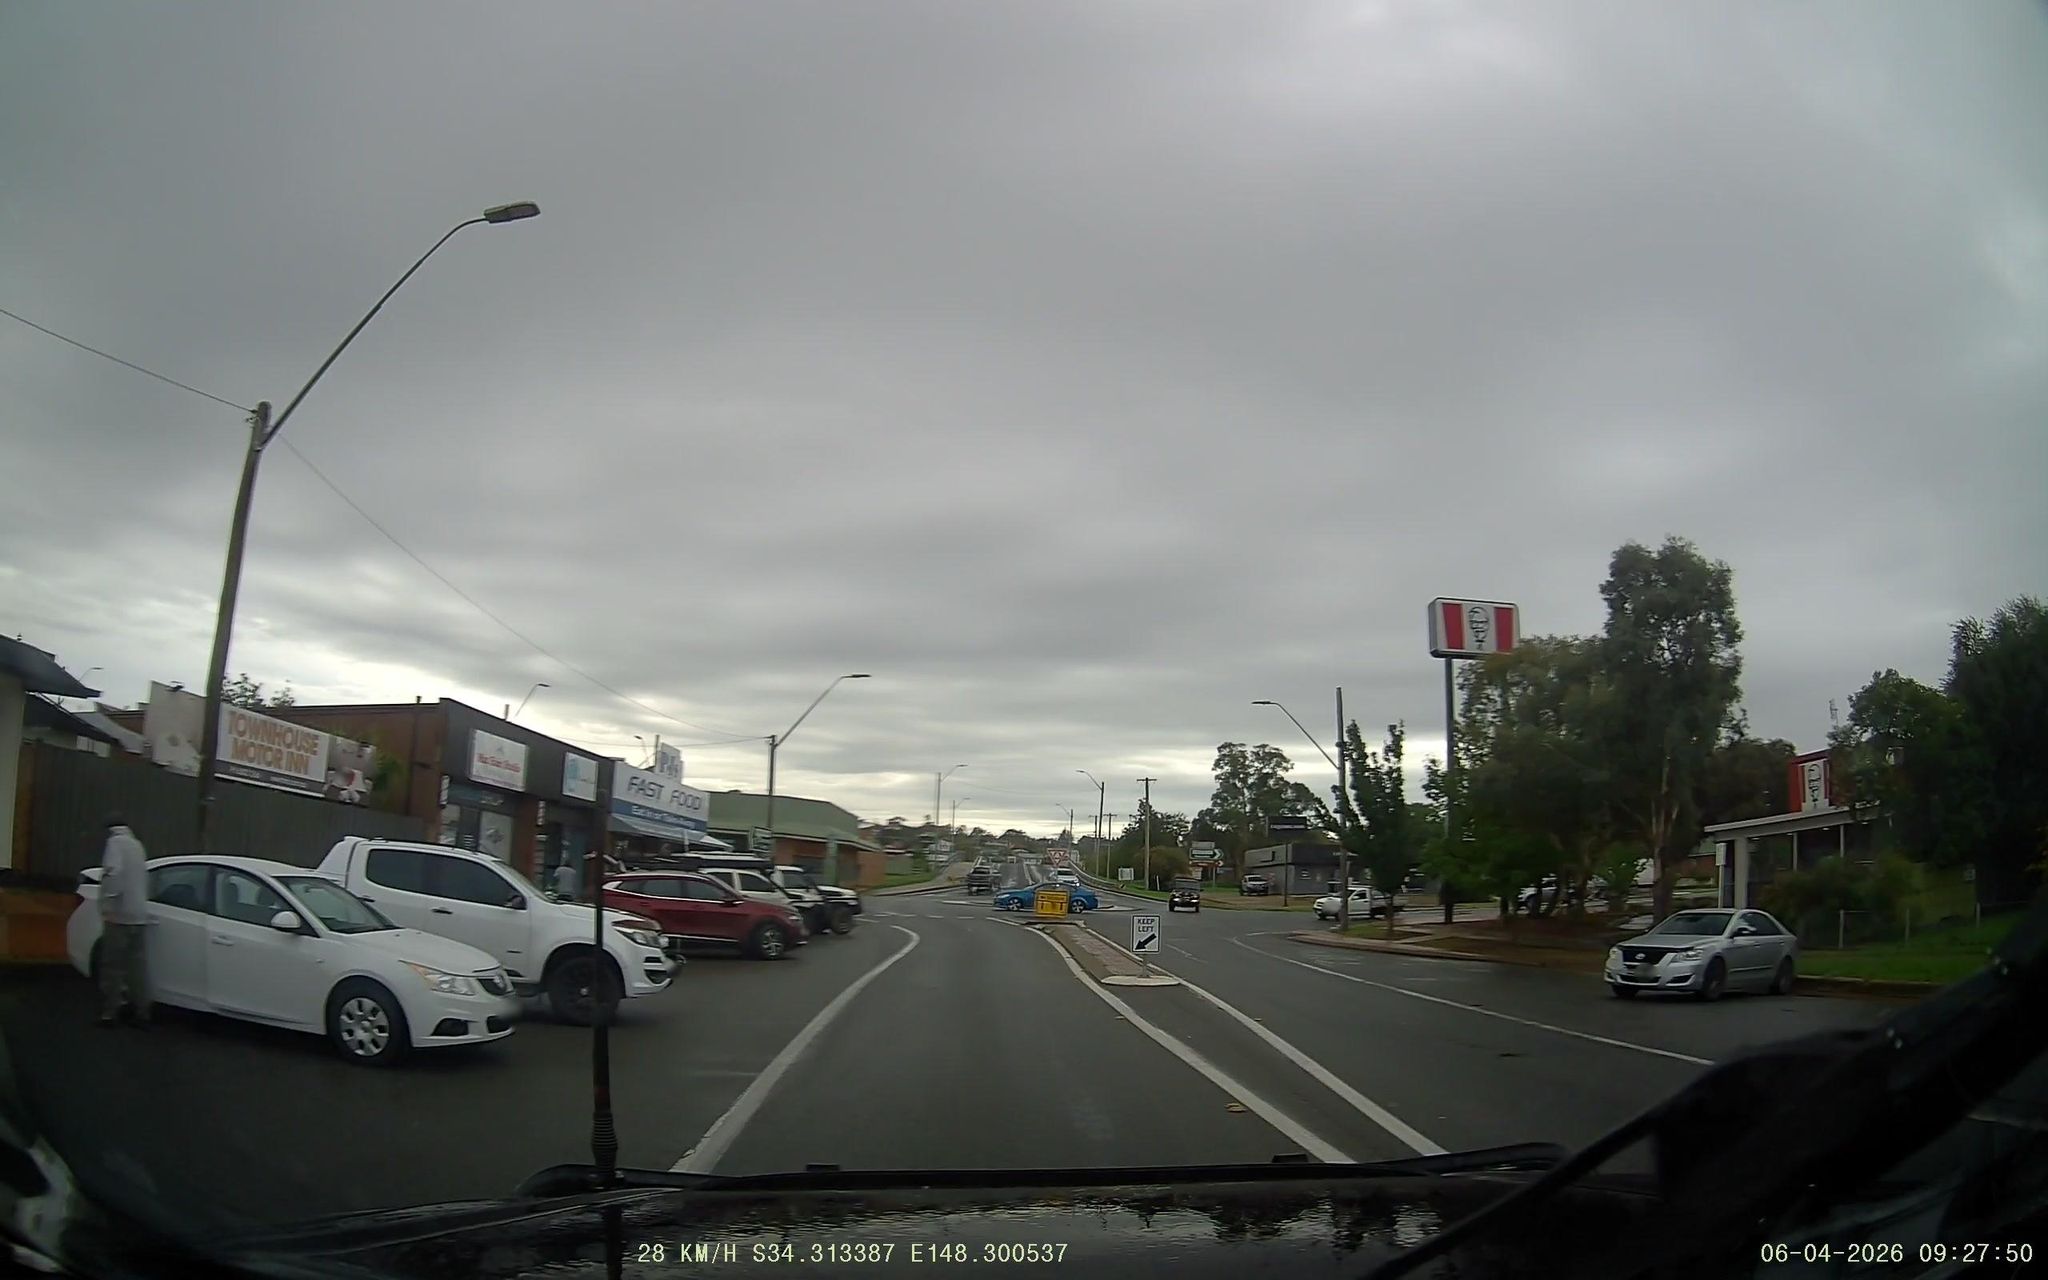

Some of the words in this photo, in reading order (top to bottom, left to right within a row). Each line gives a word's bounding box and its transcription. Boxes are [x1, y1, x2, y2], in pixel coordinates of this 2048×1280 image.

[228, 710, 320, 757] TOWNHOUSE
[231, 737, 284, 771] MOTOR
[284, 751, 310, 776] INN
[628, 776, 665, 800] FAST
[669, 789, 701, 811] FOOD
